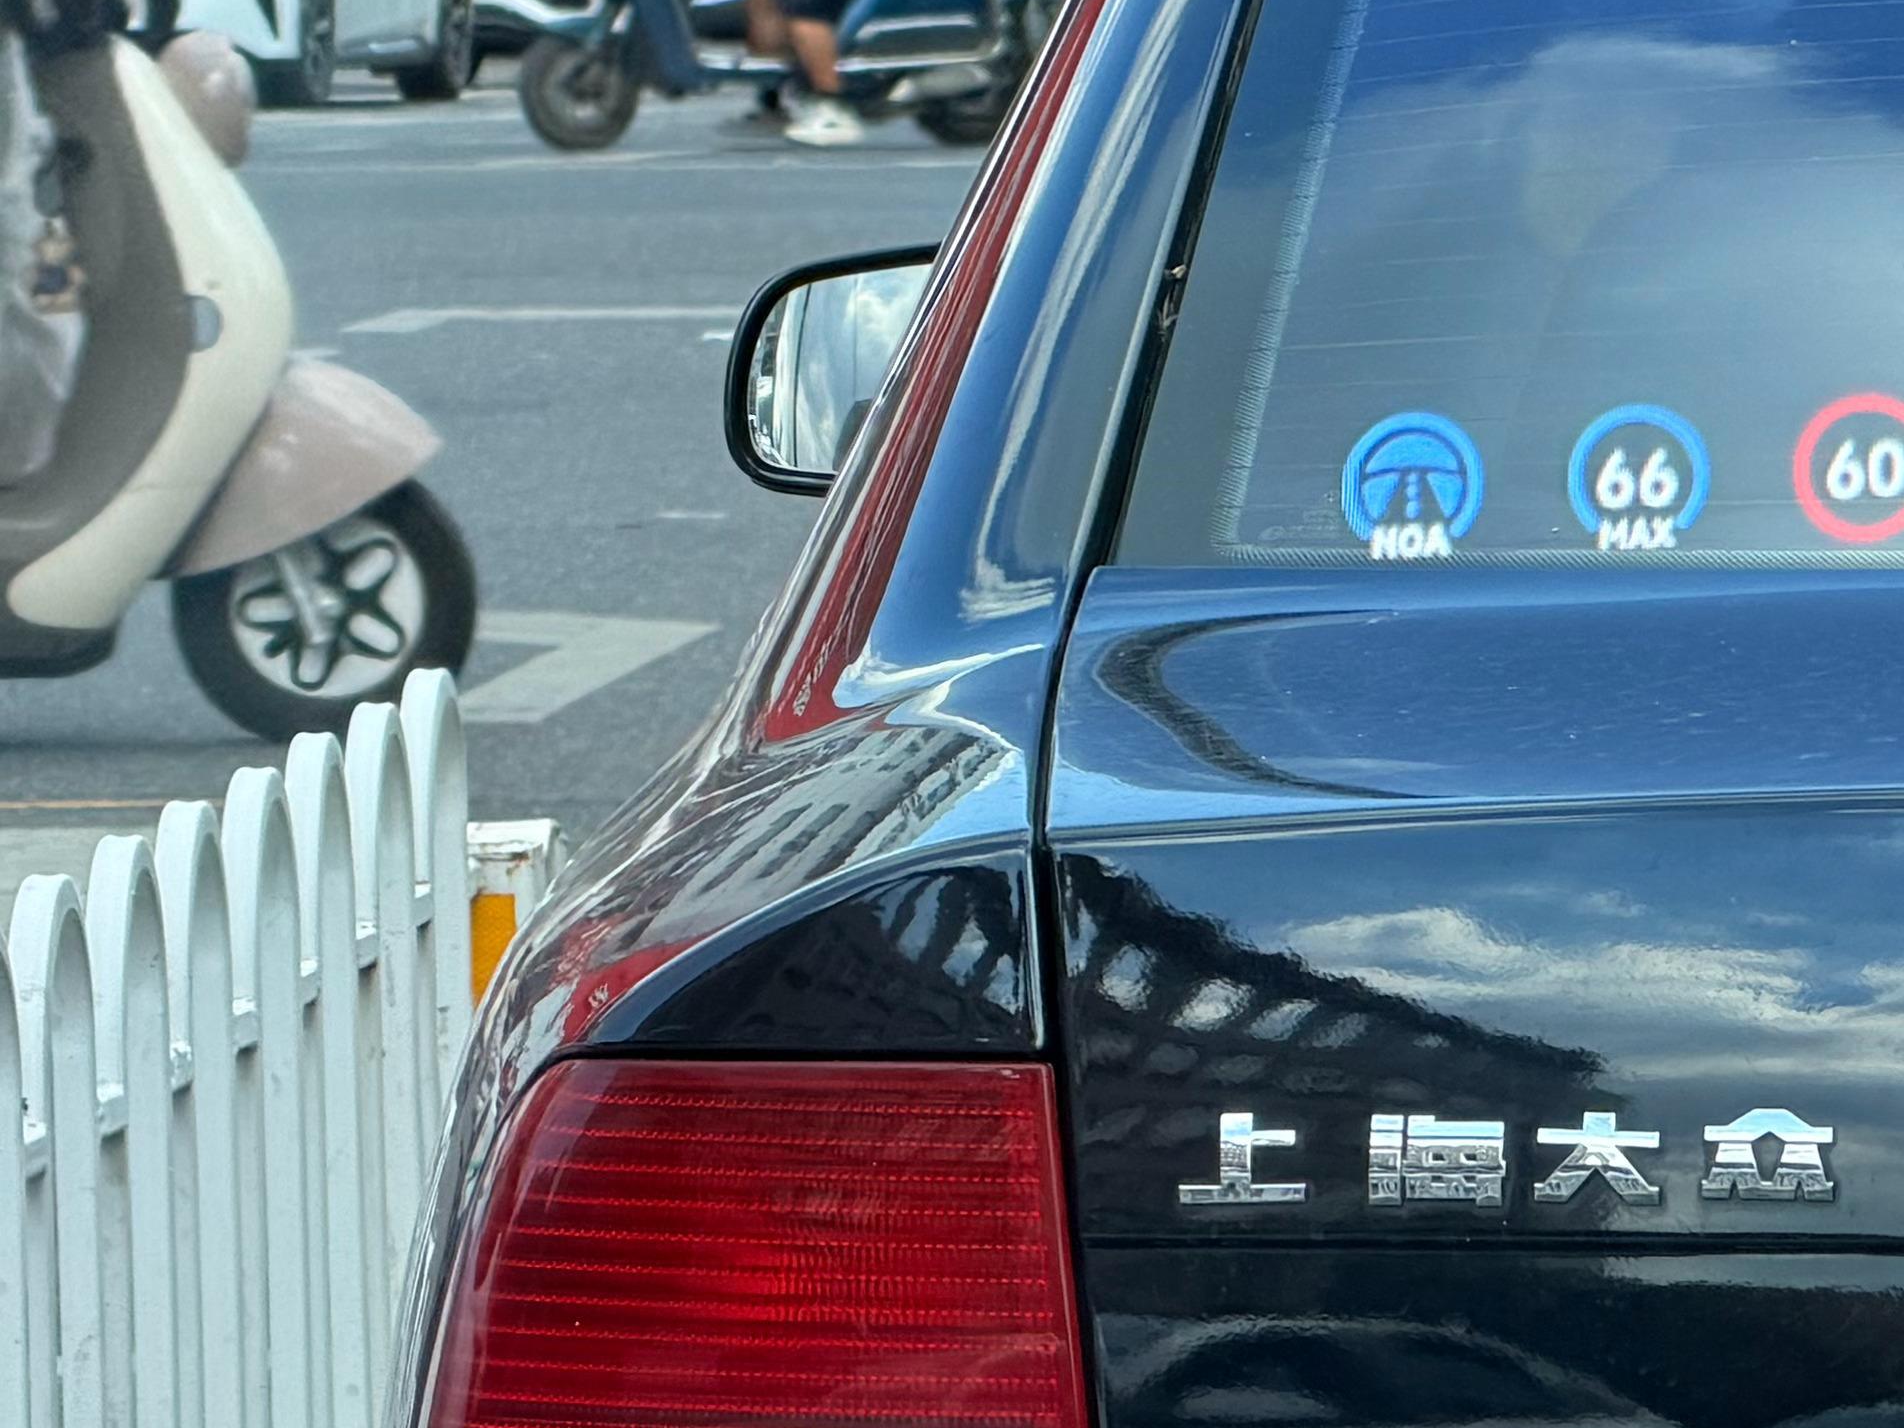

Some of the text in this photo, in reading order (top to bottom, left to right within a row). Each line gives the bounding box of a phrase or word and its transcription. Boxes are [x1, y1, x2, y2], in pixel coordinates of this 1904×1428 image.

[1595, 446, 1680, 509] 66
[1369, 522, 1455, 561] NOA
[1597, 517, 1677, 551] MAX
[1178, 1107, 1836, 1207] 上海大众
